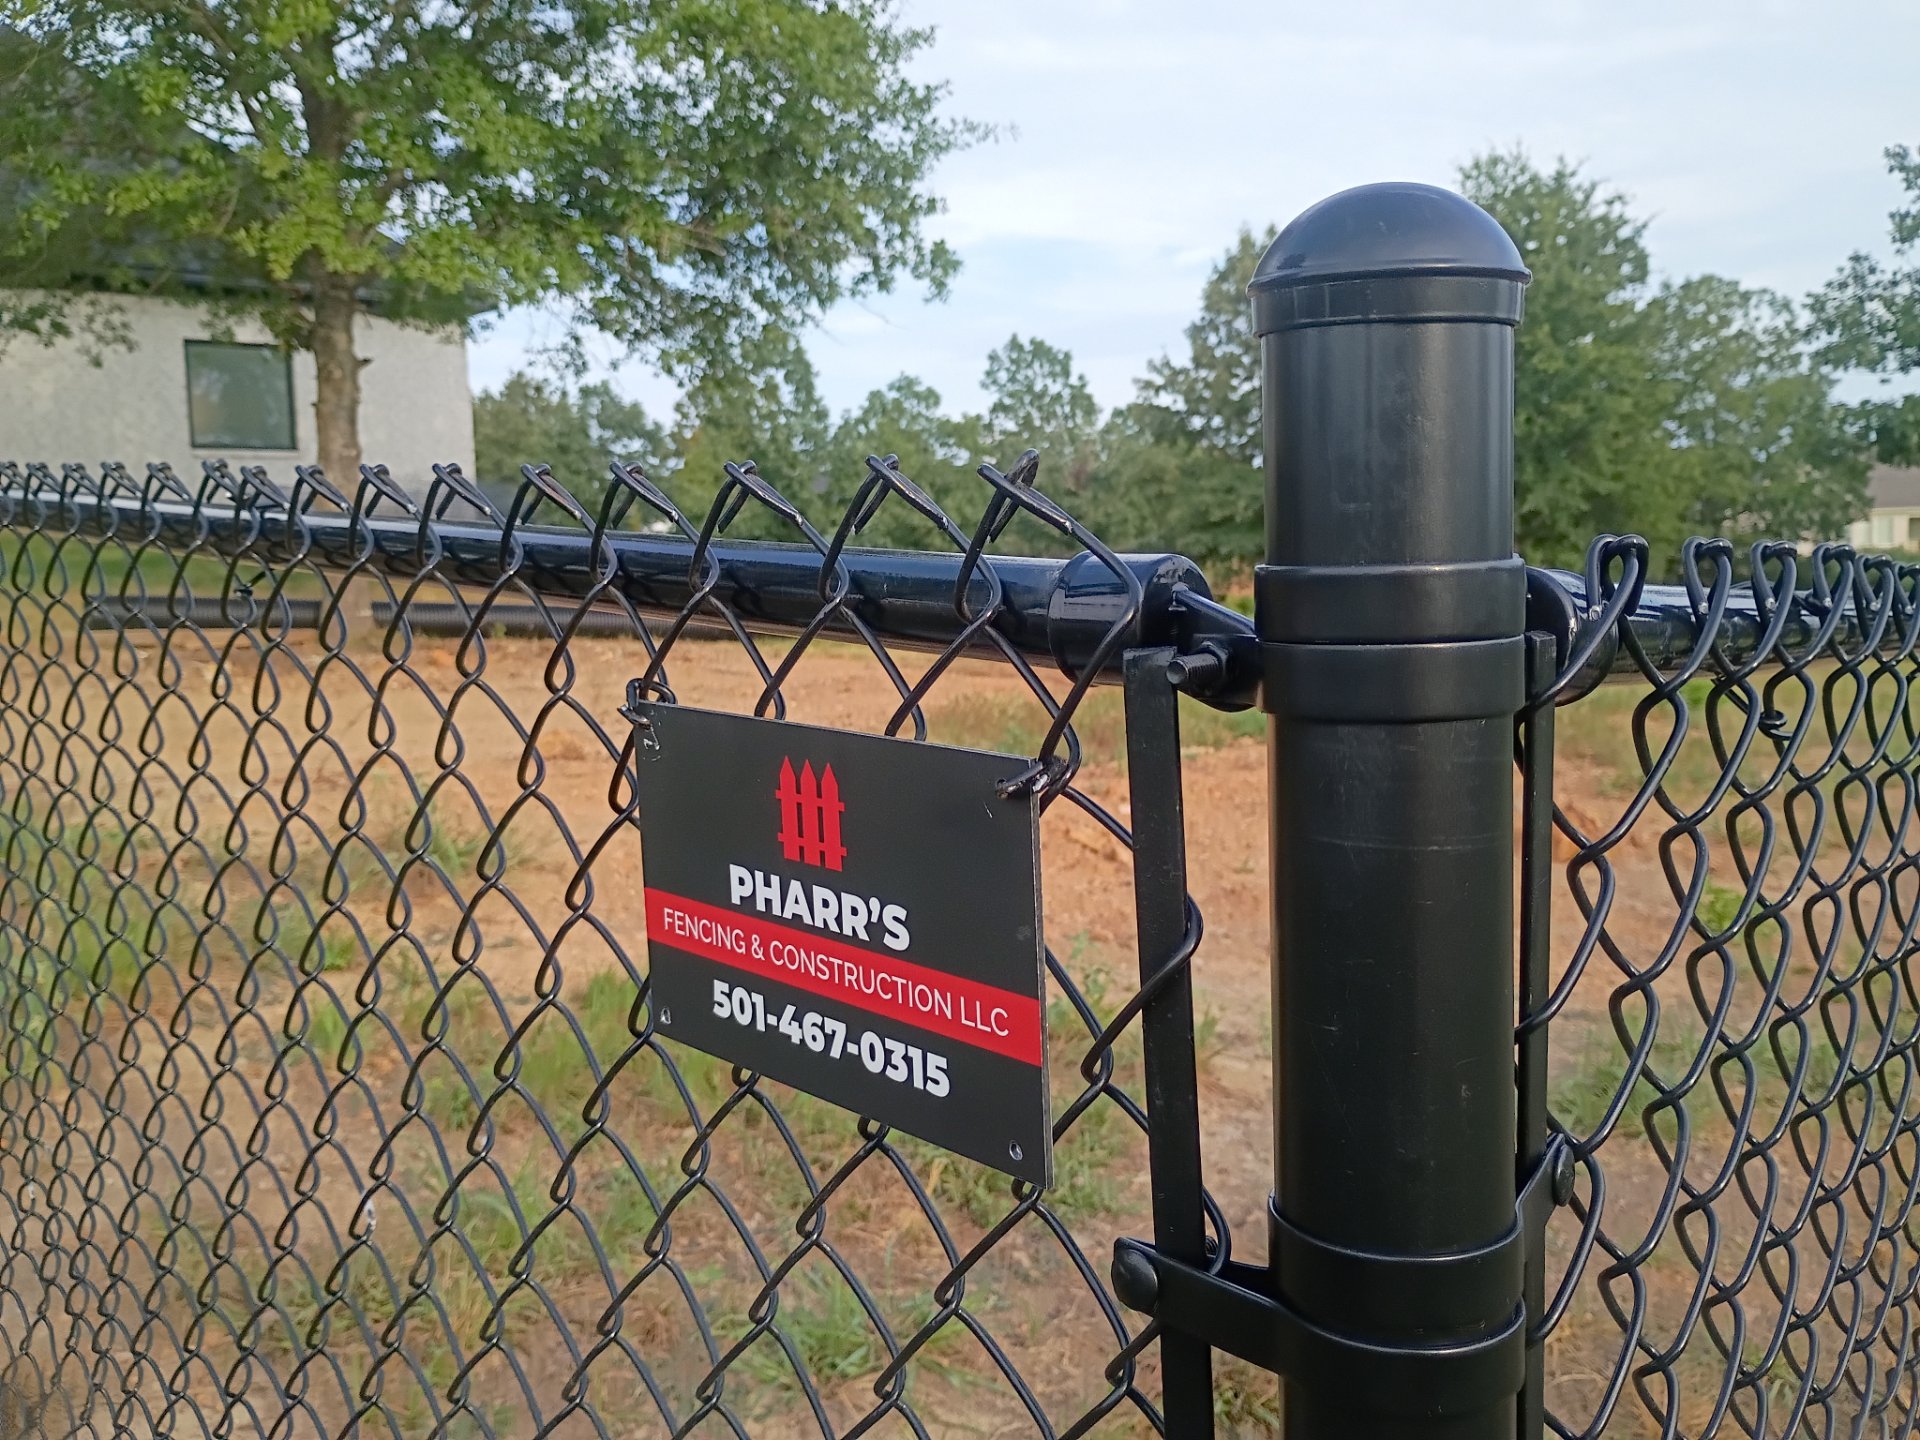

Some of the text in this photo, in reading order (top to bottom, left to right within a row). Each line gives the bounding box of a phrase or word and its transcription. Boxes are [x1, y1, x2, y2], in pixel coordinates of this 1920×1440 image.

[729, 863, 911, 951] PHARR'S
[663, 907, 1009, 1037] FENCING & CONSTRUCTION LLC
[713, 979, 951, 1098] 501-467-0315
